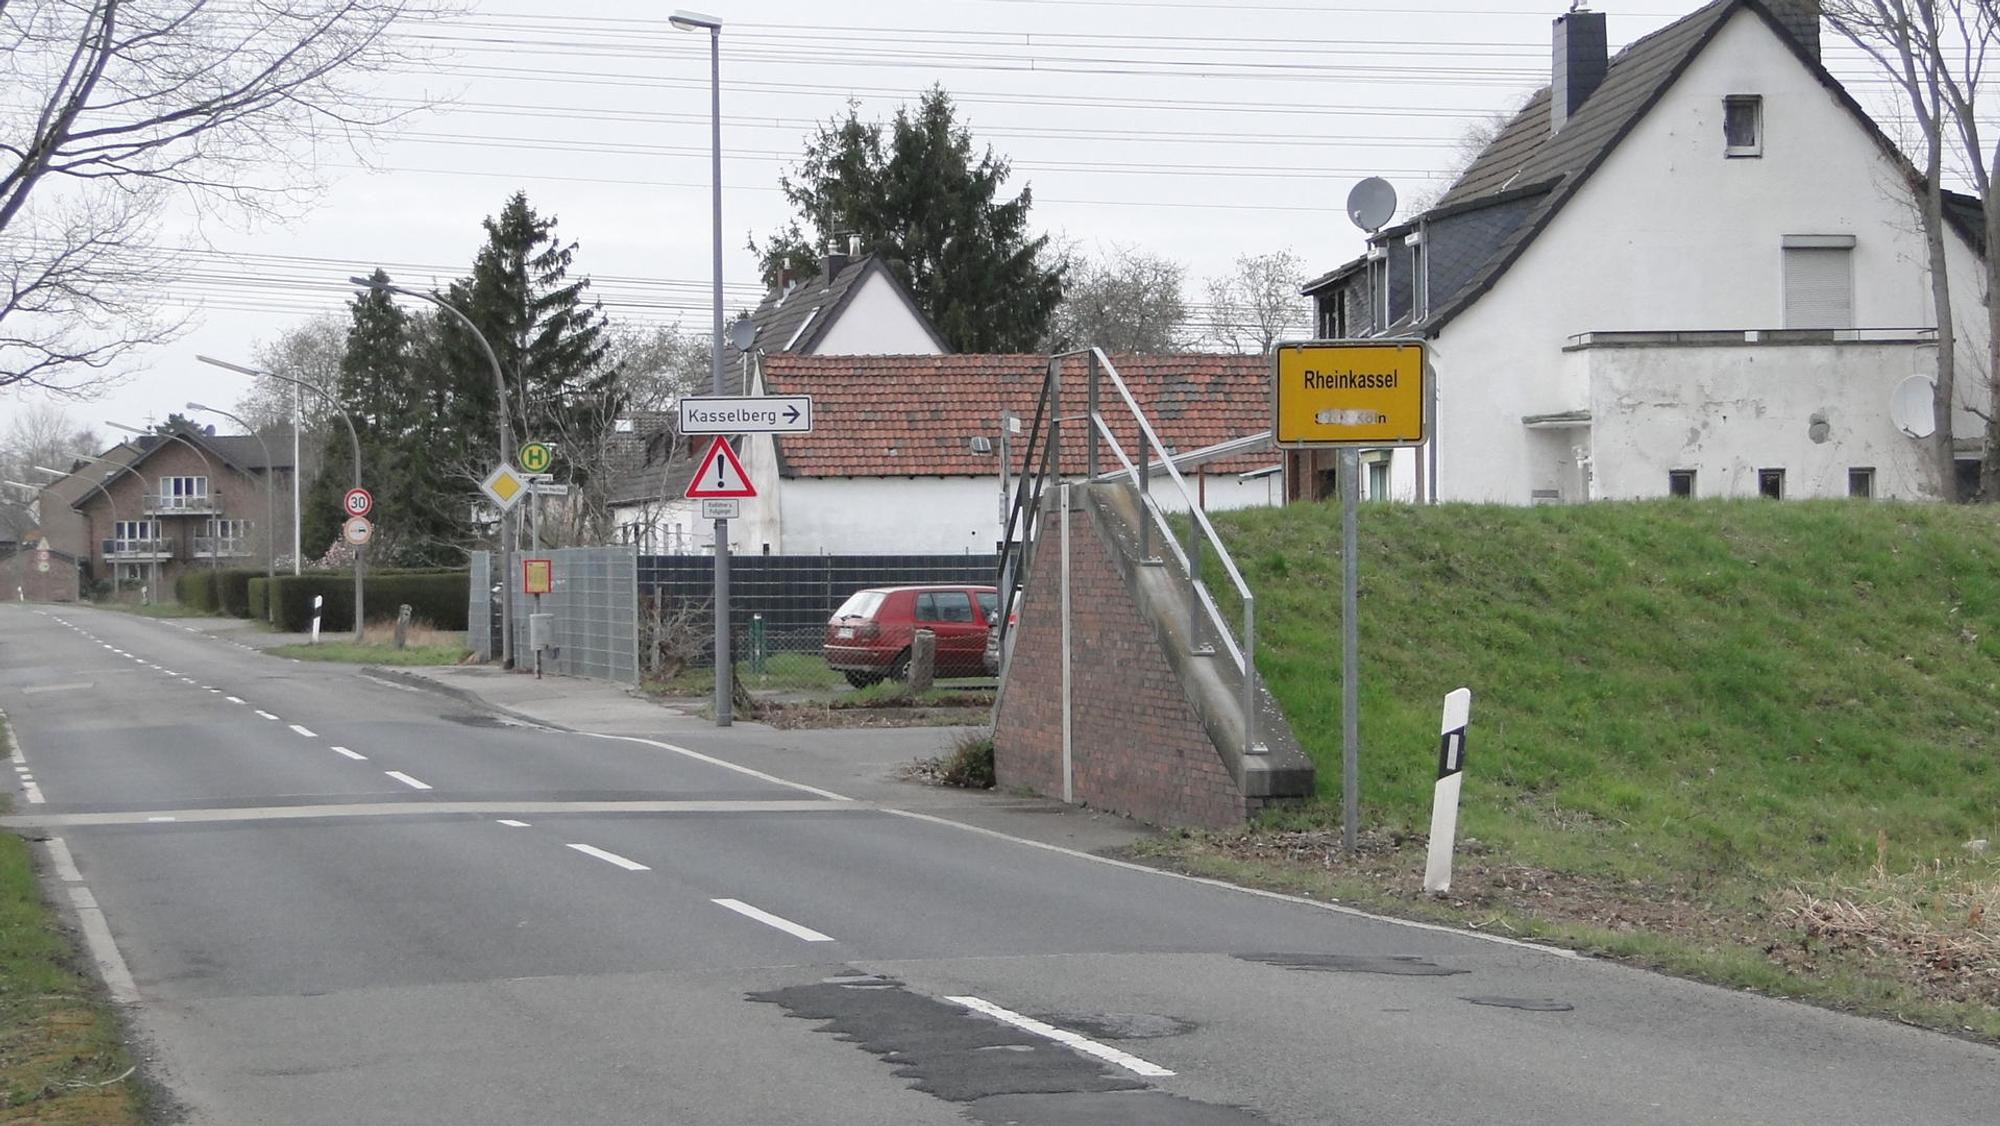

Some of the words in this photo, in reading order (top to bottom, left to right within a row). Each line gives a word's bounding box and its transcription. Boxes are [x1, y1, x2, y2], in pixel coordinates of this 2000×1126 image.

[1304, 369, 1398, 389] Rheinkassel
[688, 408, 777, 425] Kasselberg
[528, 448, 543, 465] H
[350, 496, 366, 509] 30
